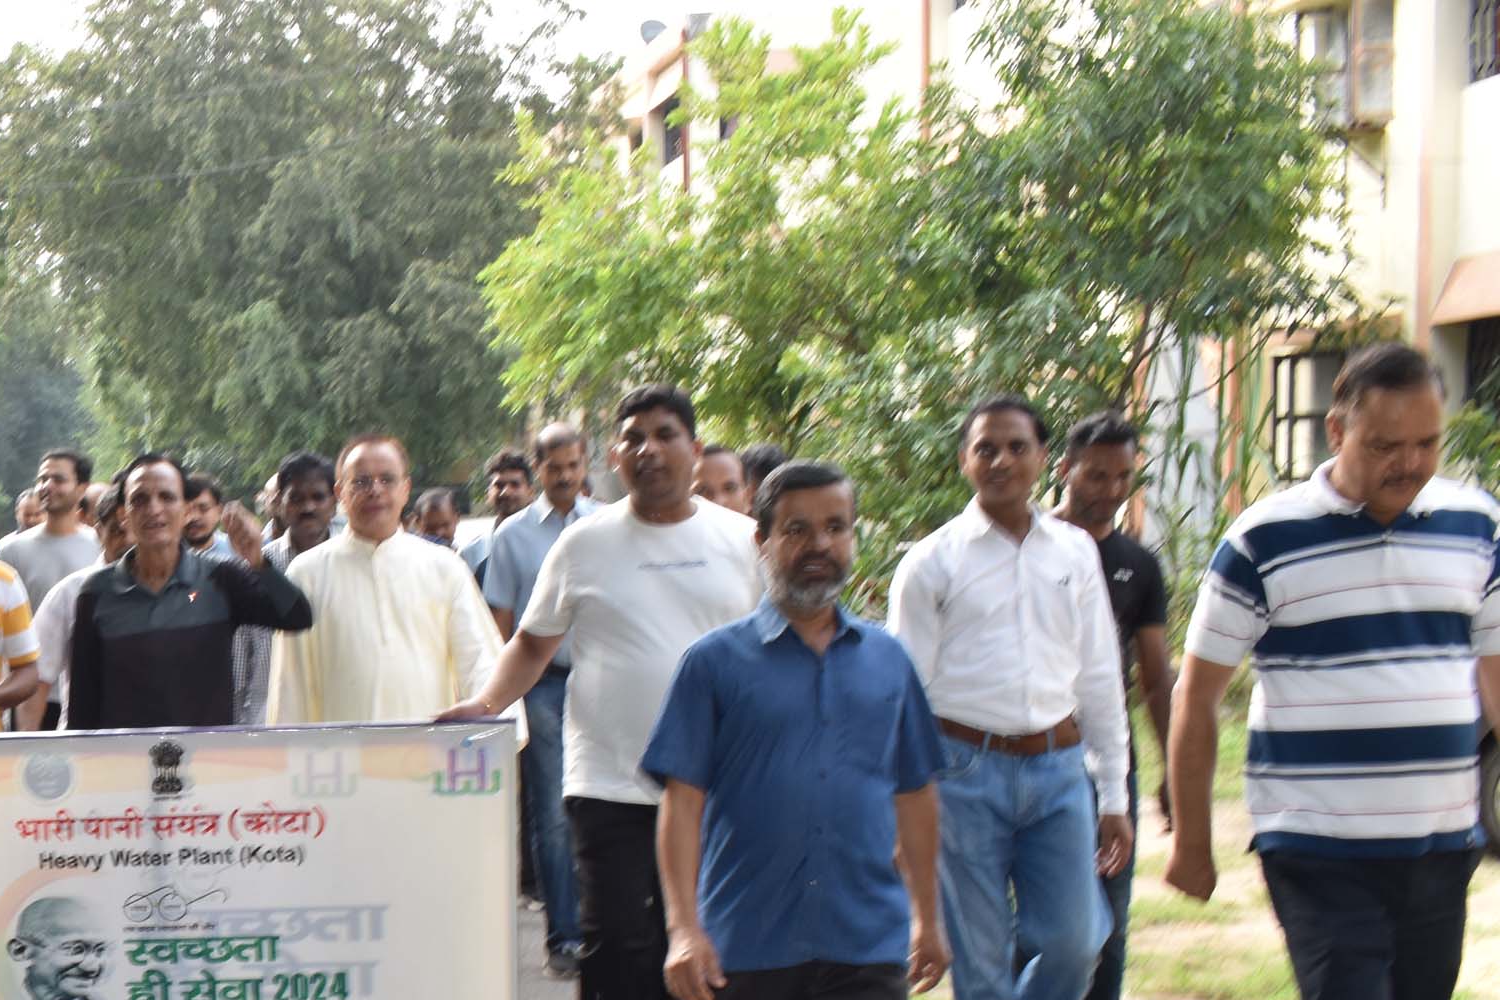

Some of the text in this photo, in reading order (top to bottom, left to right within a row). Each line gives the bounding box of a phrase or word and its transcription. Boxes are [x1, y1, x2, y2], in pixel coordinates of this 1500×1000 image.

[14, 800, 326, 842] भारी पानी संयंत्र (कोटा)
[39, 845, 305, 872] Heavy Water Plant (Kota)
[123, 935, 280, 966] स्वच्छता
